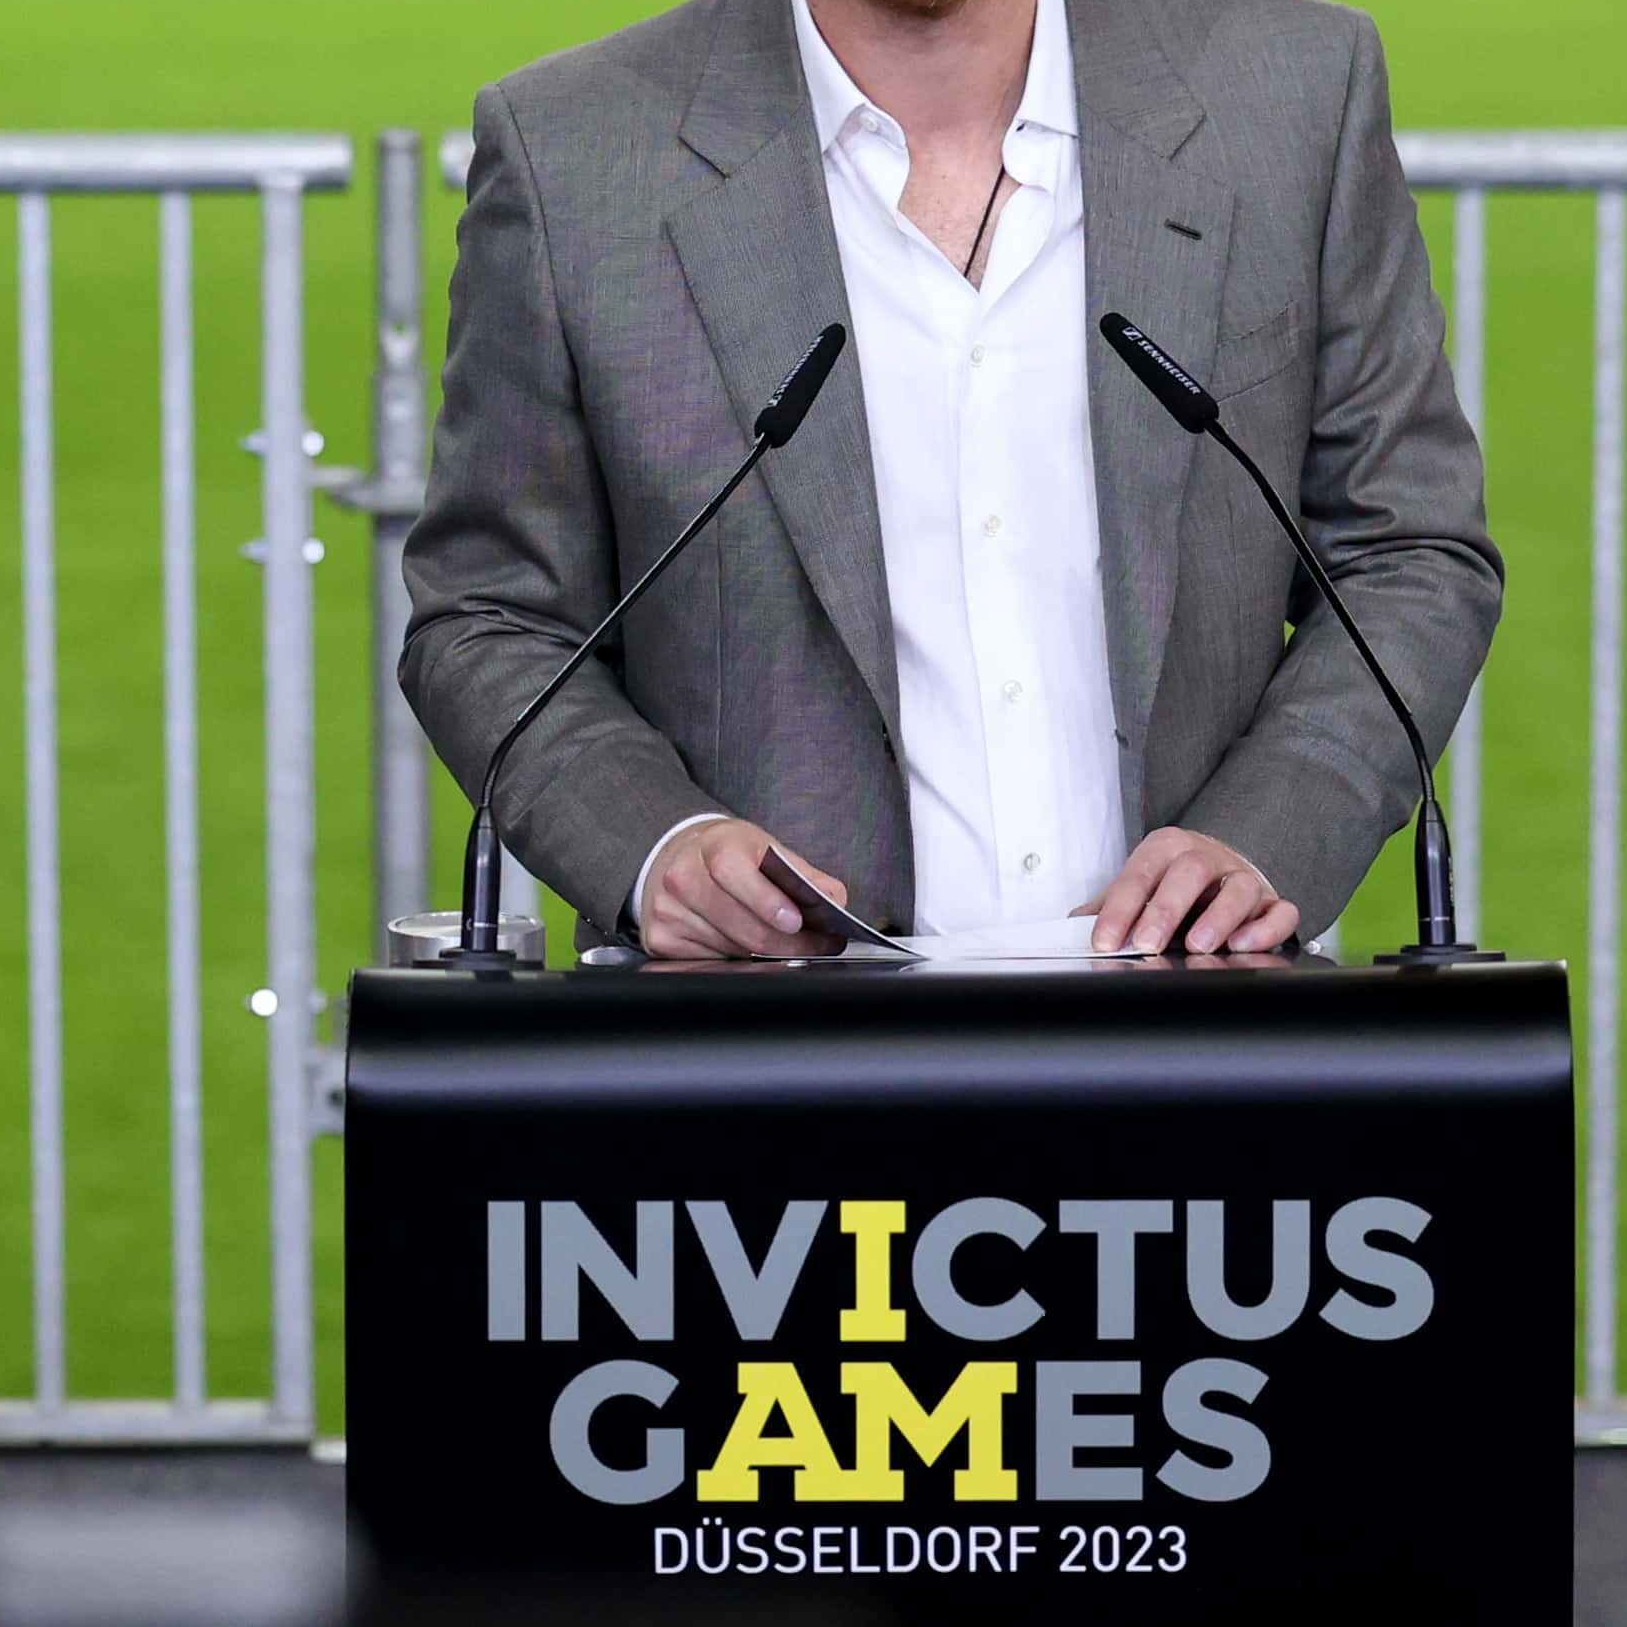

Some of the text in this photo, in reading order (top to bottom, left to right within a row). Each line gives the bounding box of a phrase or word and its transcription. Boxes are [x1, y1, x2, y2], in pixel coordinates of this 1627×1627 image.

[1138, 340, 1201, 394] SENNHEISER
[487, 1196, 1435, 1342] INVICTUS
[549, 1357, 1272, 1505] GAMES
[653, 1517, 1187, 1575] DÜSSELDORF 2023
